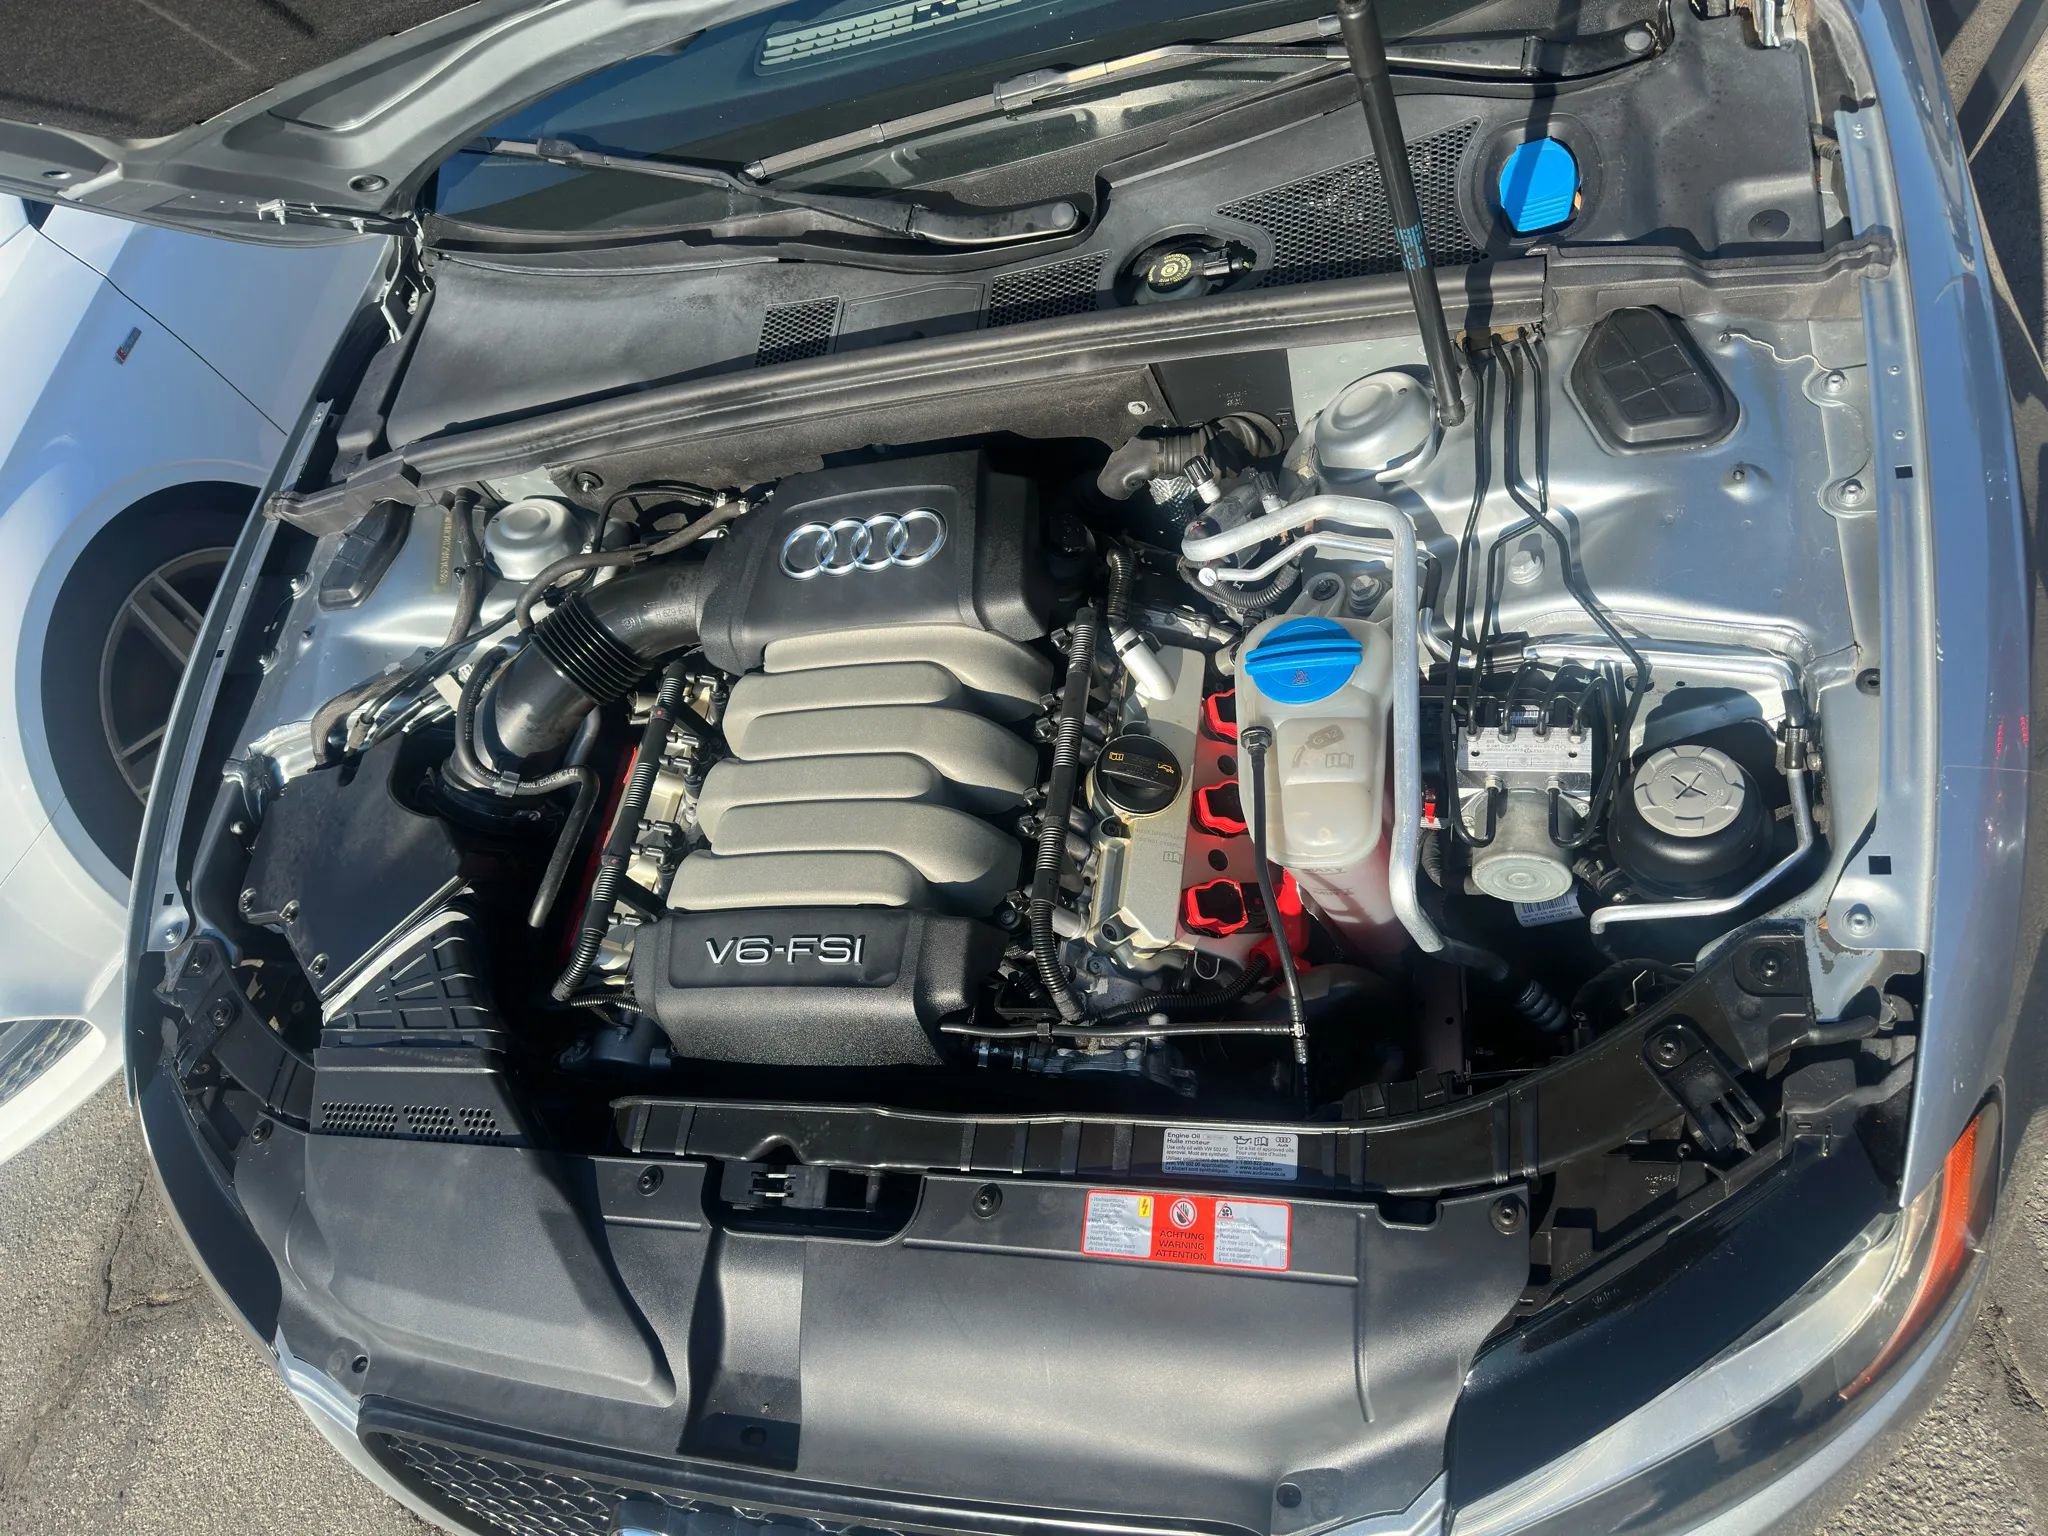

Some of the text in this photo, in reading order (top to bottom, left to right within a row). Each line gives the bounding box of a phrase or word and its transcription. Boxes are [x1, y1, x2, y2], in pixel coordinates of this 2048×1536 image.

[705, 934, 866, 967] V6-FSI
[1160, 1230, 1205, 1241] ACHTUNG
[1159, 1240, 1205, 1251] WARNING
[1155, 1249, 1207, 1261] ATTENTION
